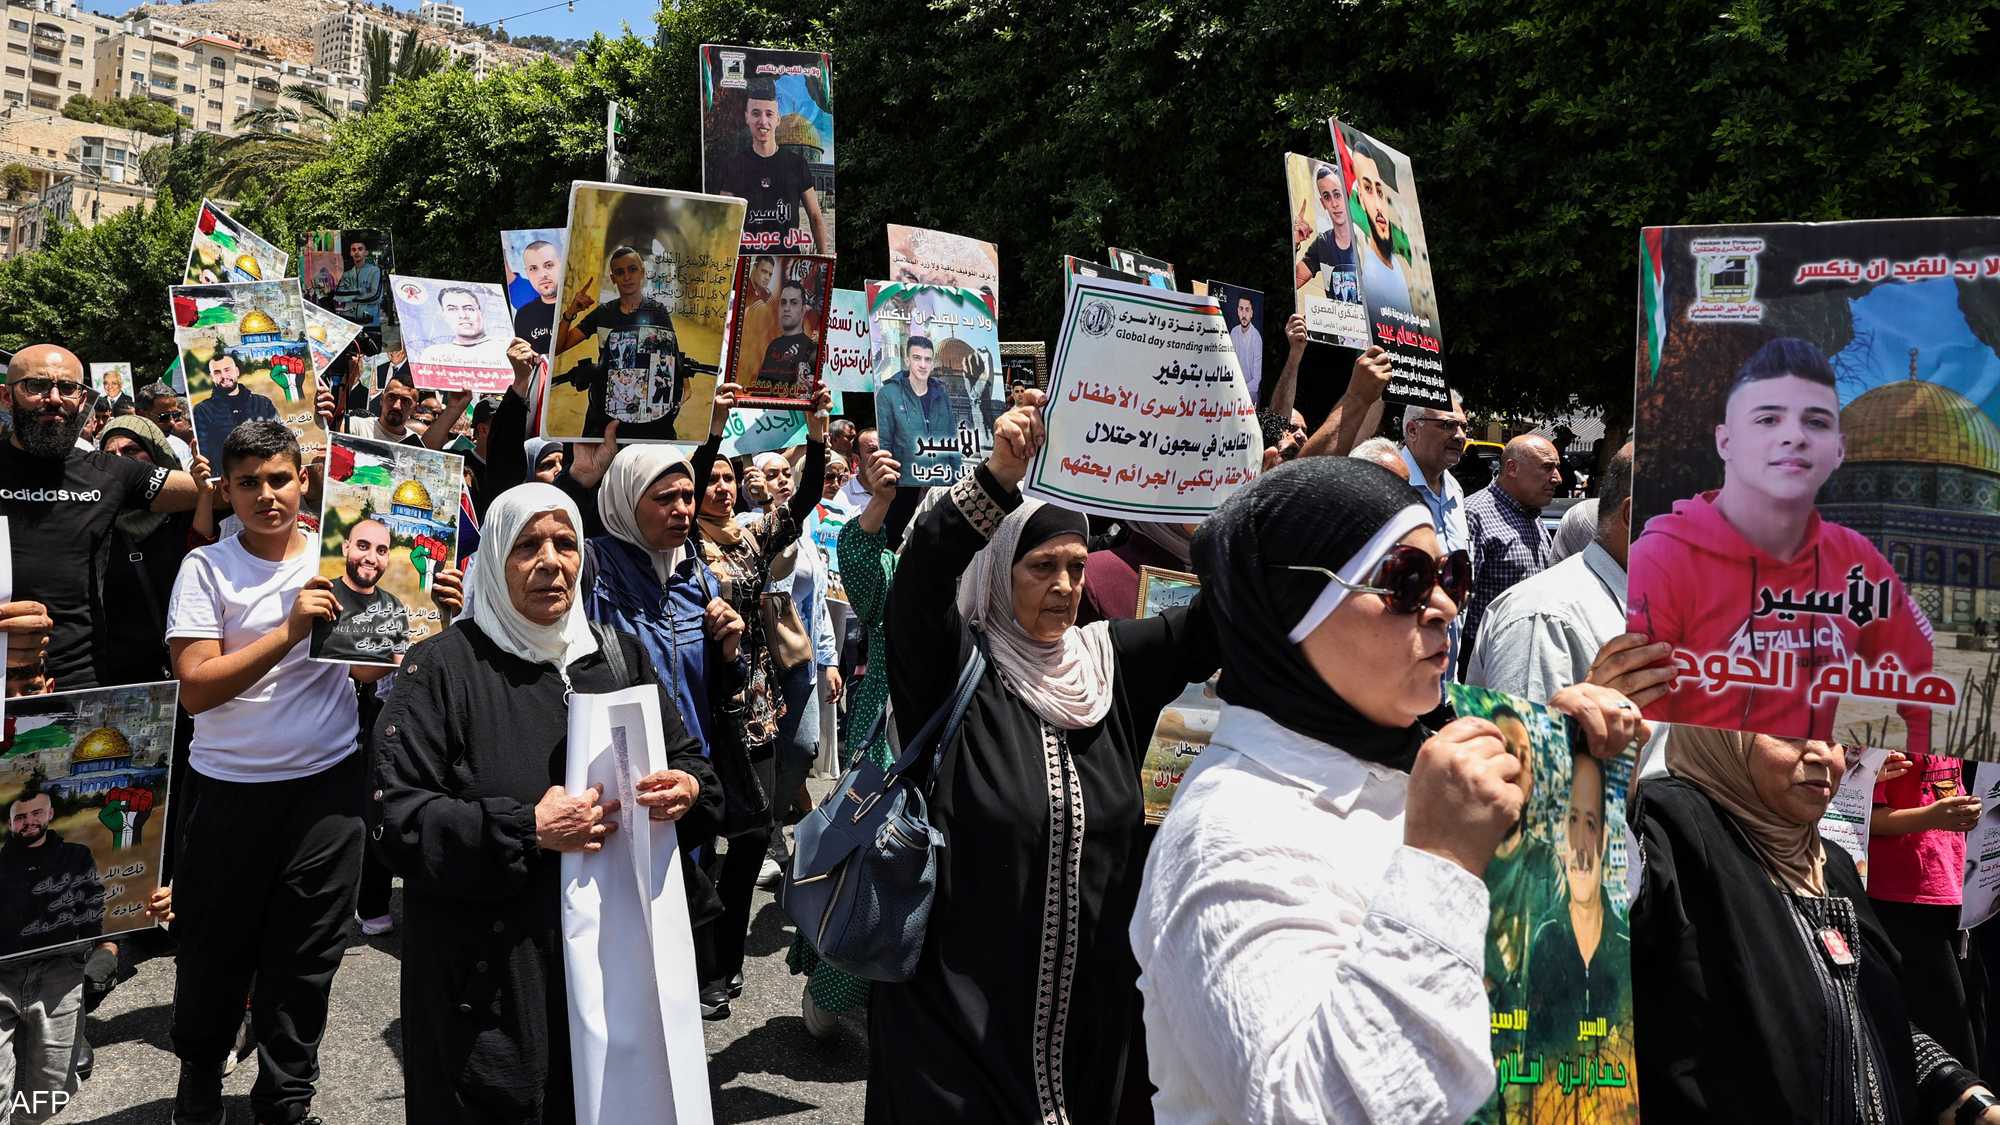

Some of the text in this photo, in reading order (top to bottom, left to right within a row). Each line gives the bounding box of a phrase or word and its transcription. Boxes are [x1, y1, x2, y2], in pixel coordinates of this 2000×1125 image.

[749, 199, 792, 224] الأسير
[783, 228, 814, 249] جلال
[1795, 259, 1861, 284] ينكسر
[1865, 258, 1887, 281] ان
[1893, 256, 1947, 280] للقيد
[1953, 261, 1977, 279] بد
[873, 308, 992, 330] ولا بد للقيد ان ينكسر
[1119, 311, 1166, 331] والأسرى
[1311, 303, 1337, 316] المصري
[1168, 318, 1195, 333] غزة
[1376, 322, 1440, 354] محمد حسام عبيد
[1116, 329, 1146, 344] Global
[1148, 334, 1165, 349] day
[1166, 339, 1203, 354] standing
[1203, 343, 1218, 353] with
[1151, 359, 1204, 389] بتوفير
[1068, 380, 1256, 423] ماية الدولية للأسرى الأطفال
[915, 420, 981, 458] الأسير
[1085, 421, 1252, 461] القابعين في سجون الاحتلال
[912, 464, 952, 481] زكريا
[1060, 454, 1112, 480] بحقهم
[1115, 465, 1176, 490] الجرائم
[1177, 469, 1223, 496] مرتكبي
[1752, 564, 1891, 628] الأسير
[1728, 618, 1850, 666] METALLICA
[1809, 654, 1958, 706] هشام
[1490, 1008, 1528, 1035] الاسي
[1577, 1016, 1607, 1041] الاسير
[1499, 1050, 1545, 1096] اسلام
[1587, 1054, 1627, 1097] حسام
